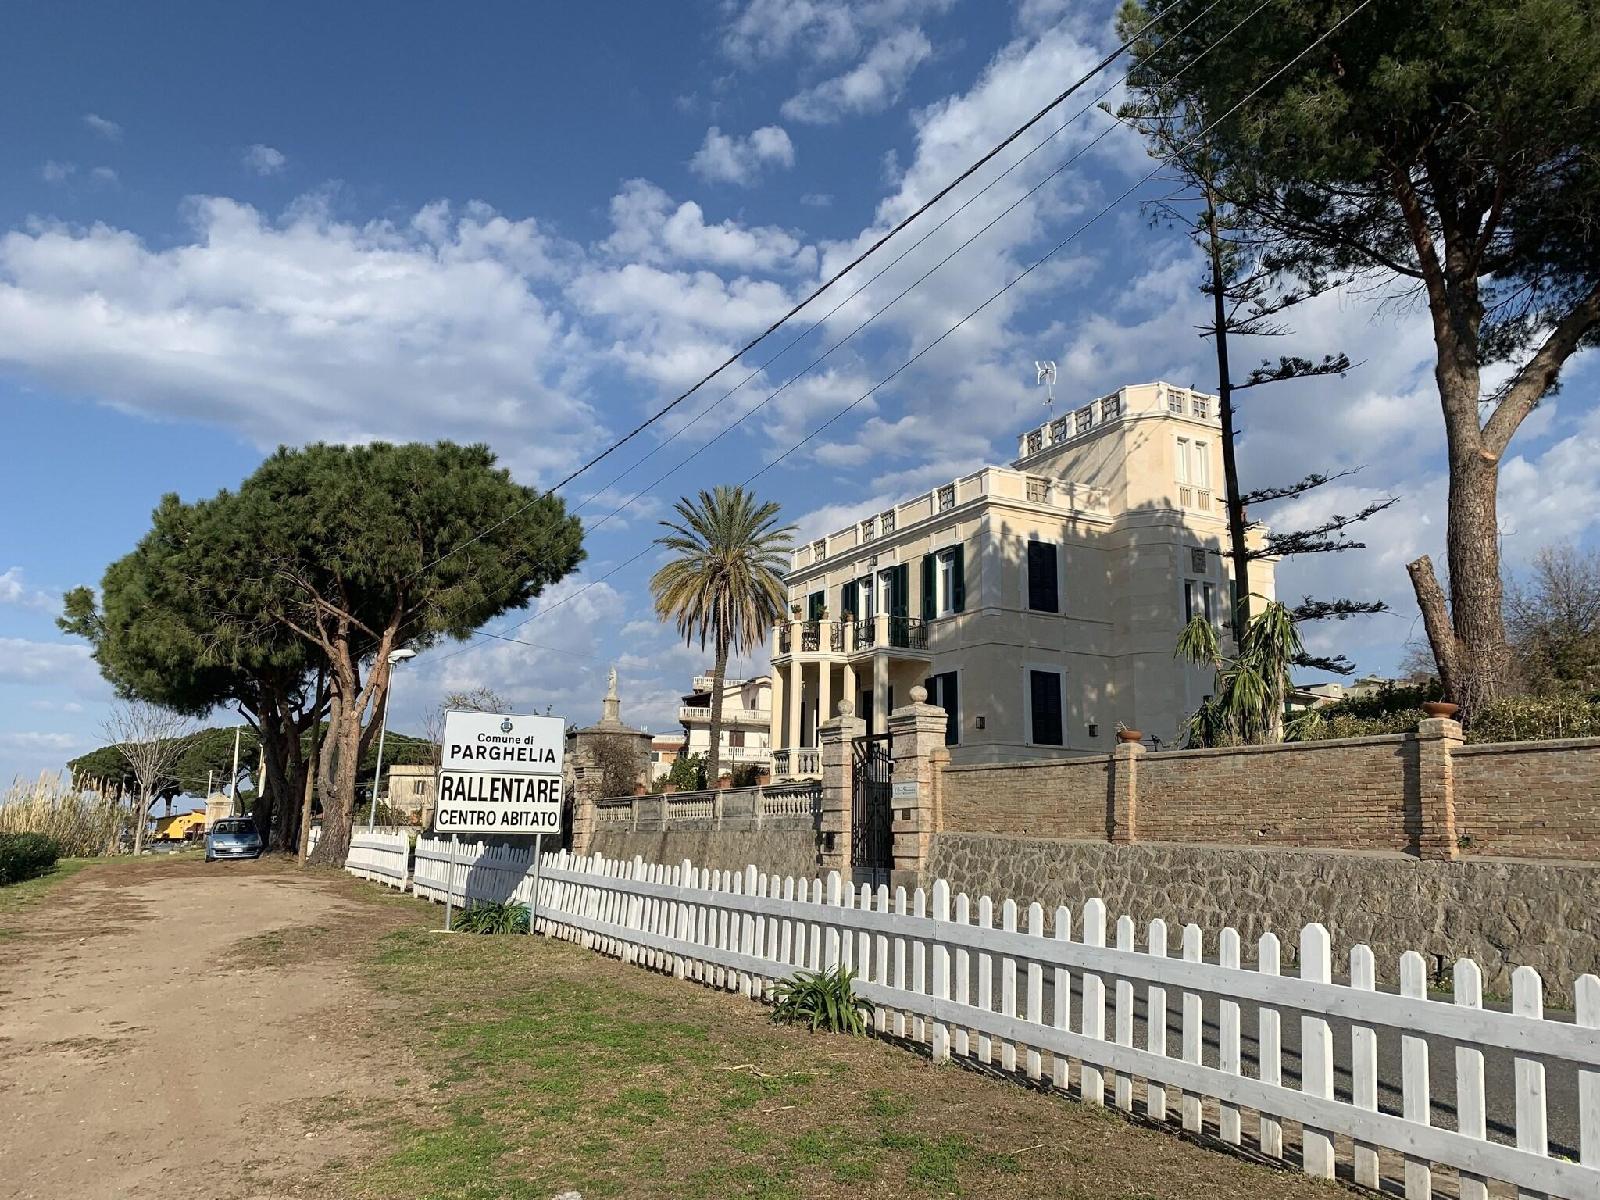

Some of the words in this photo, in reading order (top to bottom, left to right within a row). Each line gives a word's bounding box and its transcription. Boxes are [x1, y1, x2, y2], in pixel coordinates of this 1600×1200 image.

[477, 733, 521, 744] Comune
[523, 735, 534, 745] di
[450, 744, 556, 763] PARGHELIA
[440, 776, 559, 803] RALLENTARE
[439, 809, 496, 826] CENTRO
[500, 811, 557, 826] ABITATO
